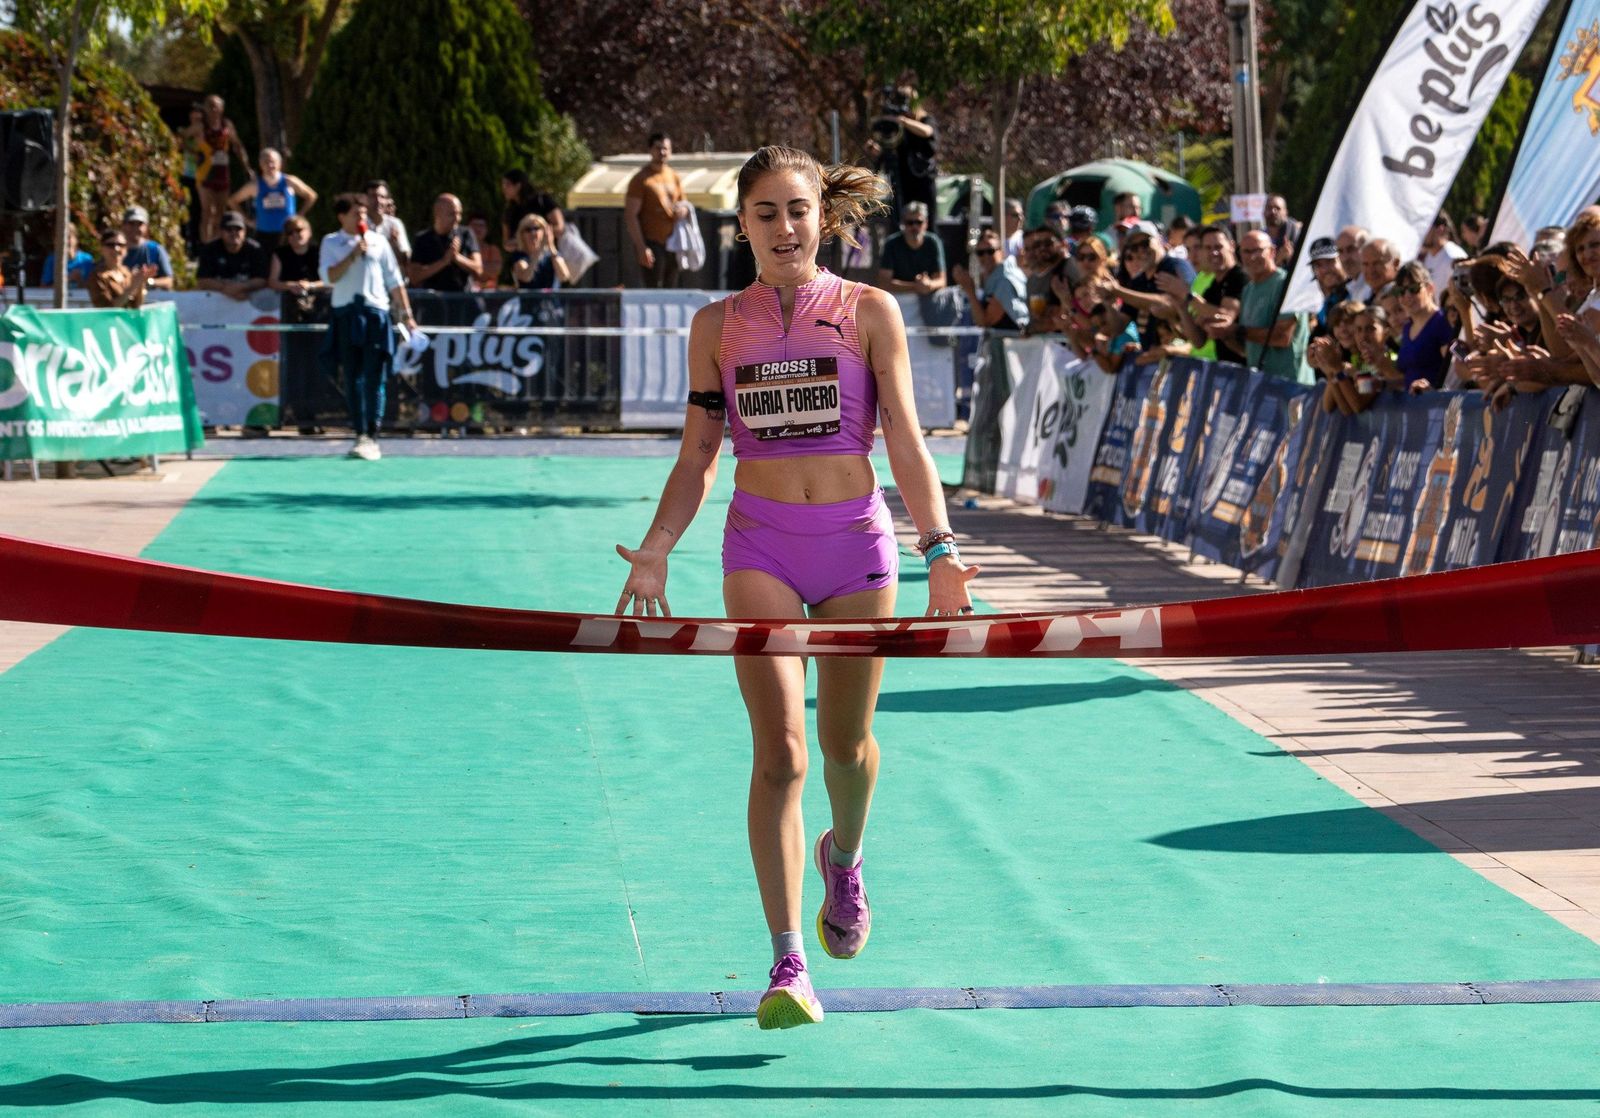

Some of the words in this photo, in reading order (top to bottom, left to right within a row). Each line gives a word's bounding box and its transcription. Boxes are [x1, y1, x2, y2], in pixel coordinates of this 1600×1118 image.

[1382, 114, 1443, 178] be
[1419, 3, 1501, 114] plus
[183, 344, 233, 383] s
[430, 312, 545, 389] plus
[761, 360, 808, 376] CROSS
[738, 389, 784, 418] MARIA
[786, 384, 838, 413] FORERO
